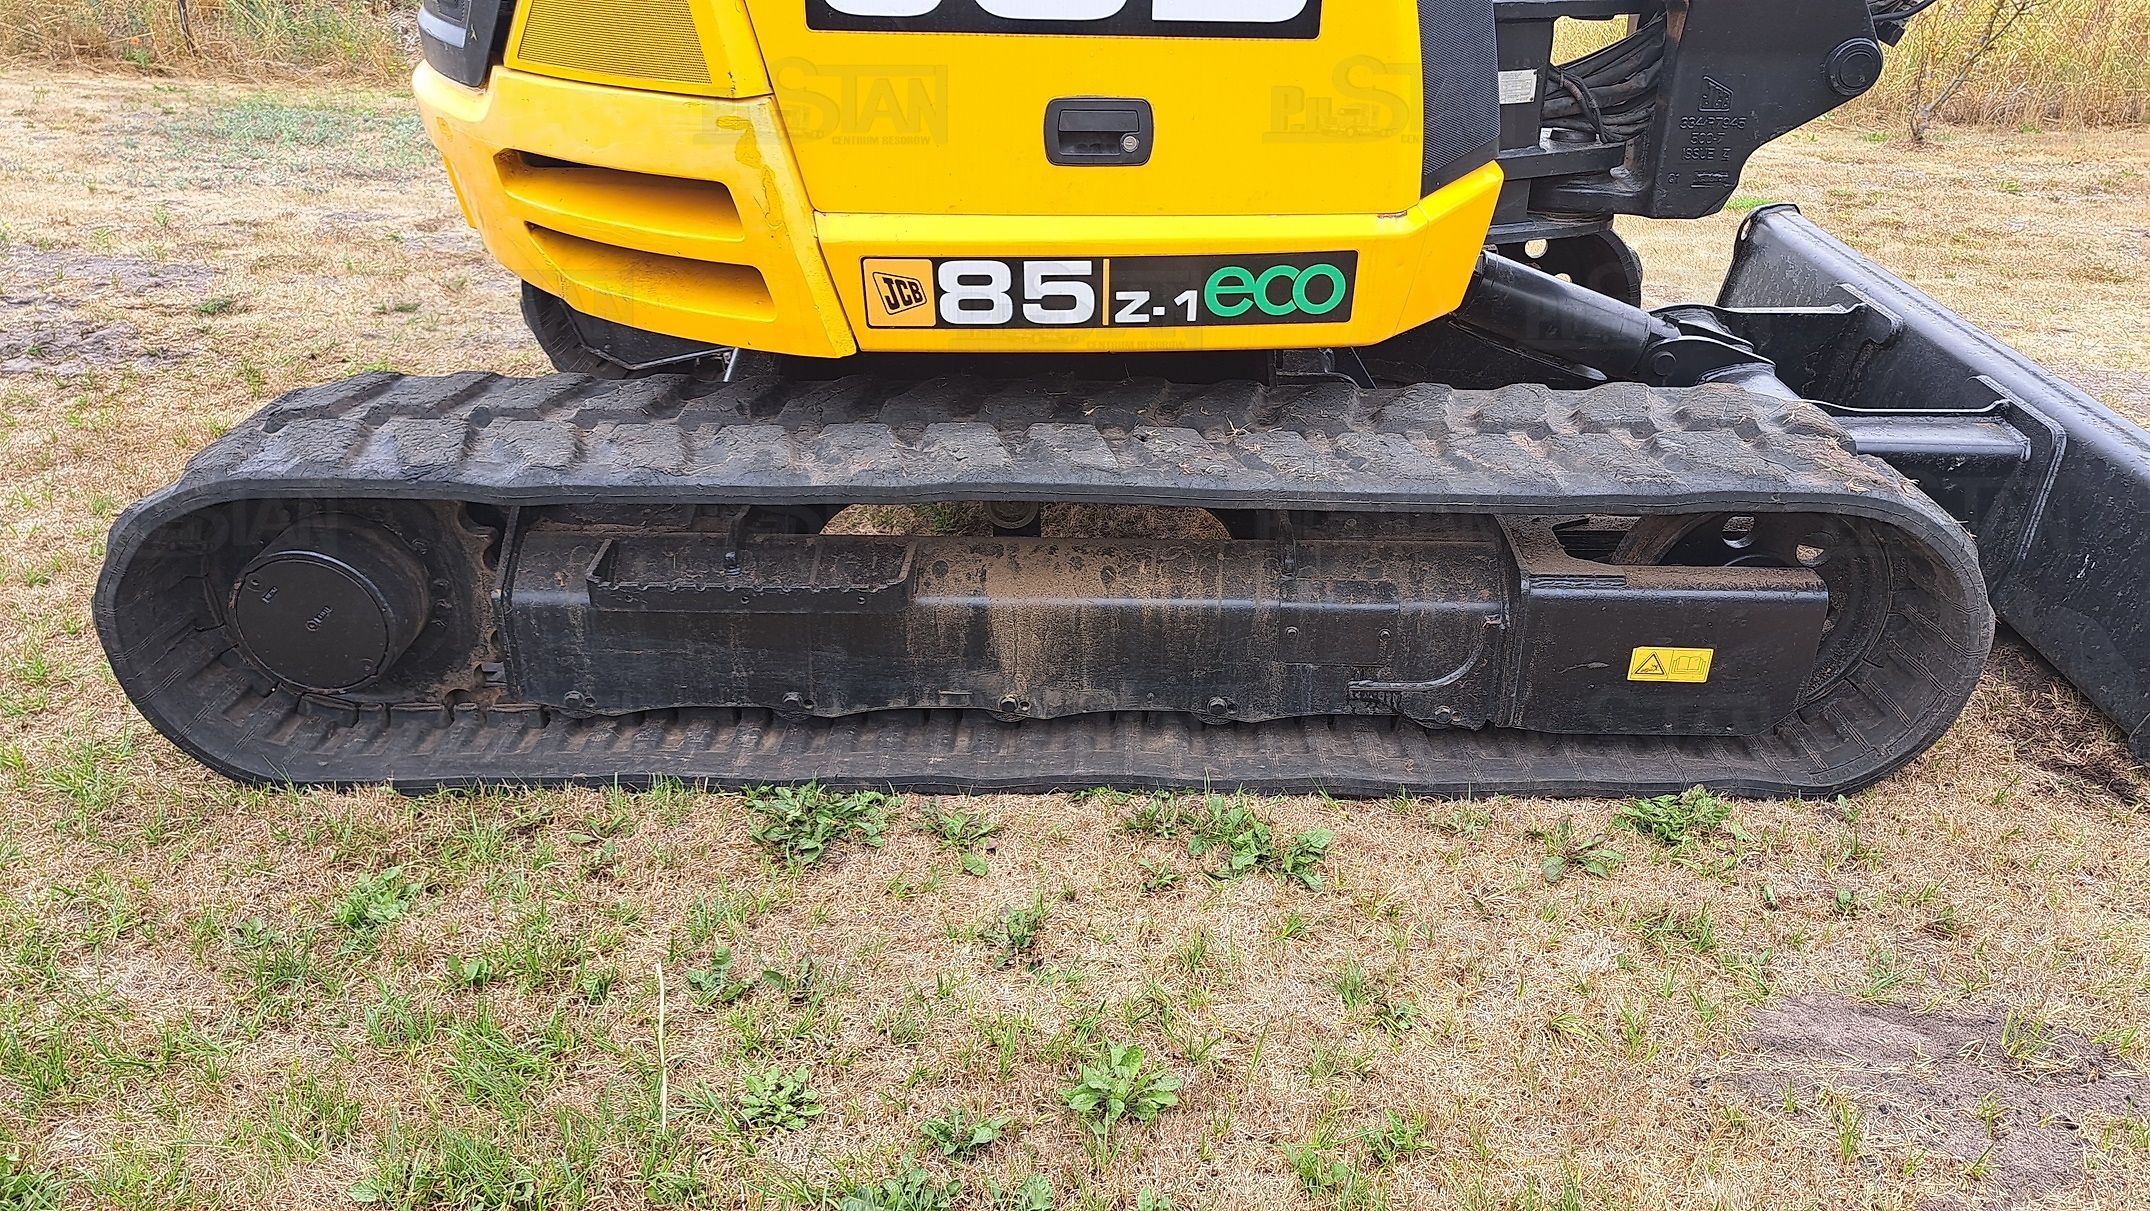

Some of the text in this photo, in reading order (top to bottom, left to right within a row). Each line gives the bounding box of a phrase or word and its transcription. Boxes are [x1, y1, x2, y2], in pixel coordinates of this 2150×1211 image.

[881, 276, 924, 310] JCB
[937, 259, 1096, 327] 85
[1203, 262, 1347, 318] eco
